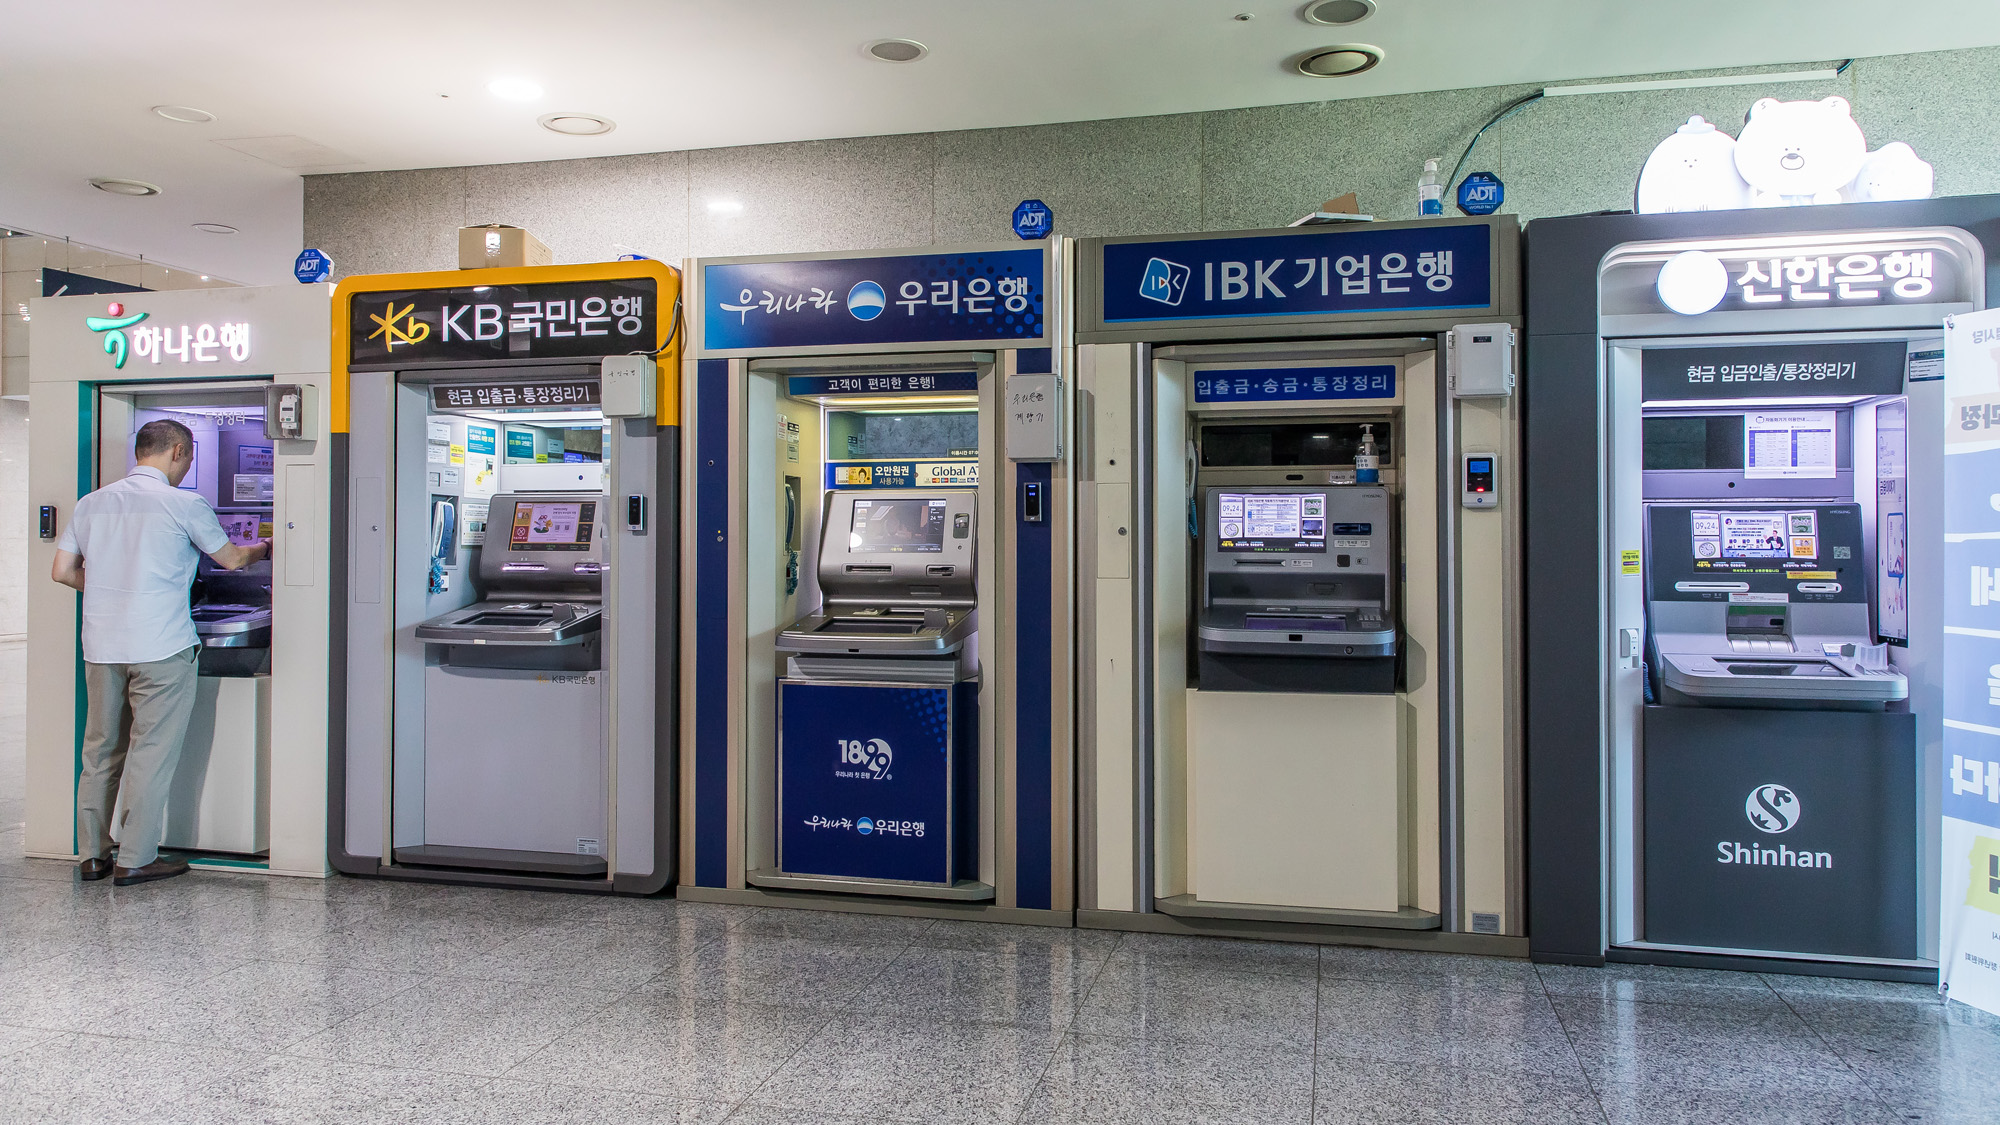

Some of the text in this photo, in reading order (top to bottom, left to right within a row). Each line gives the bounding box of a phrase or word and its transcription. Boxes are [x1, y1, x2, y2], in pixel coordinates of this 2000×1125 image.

[1466, 185, 1496, 201] ADT
[1019, 213, 1045, 227] ADT
[299, 259, 320, 271] ADT
[1736, 252, 1934, 302] 신한은행
[720, 277, 1029, 325] 우리나라 우리은행
[133, 322, 250, 364] 하나은행
[1687, 366, 1715, 383] 현금
[828, 376, 936, 391] 고객이 편리한 은행!
[447, 389, 473, 405] 현금
[874, 465, 909, 476] 오만원권
[932, 466, 979, 476] Global A
[879, 477, 905, 485] 사용가능
[803, 815, 925, 837] 우리나라 우리은행
[1717, 841, 1832, 869] Shinhan
